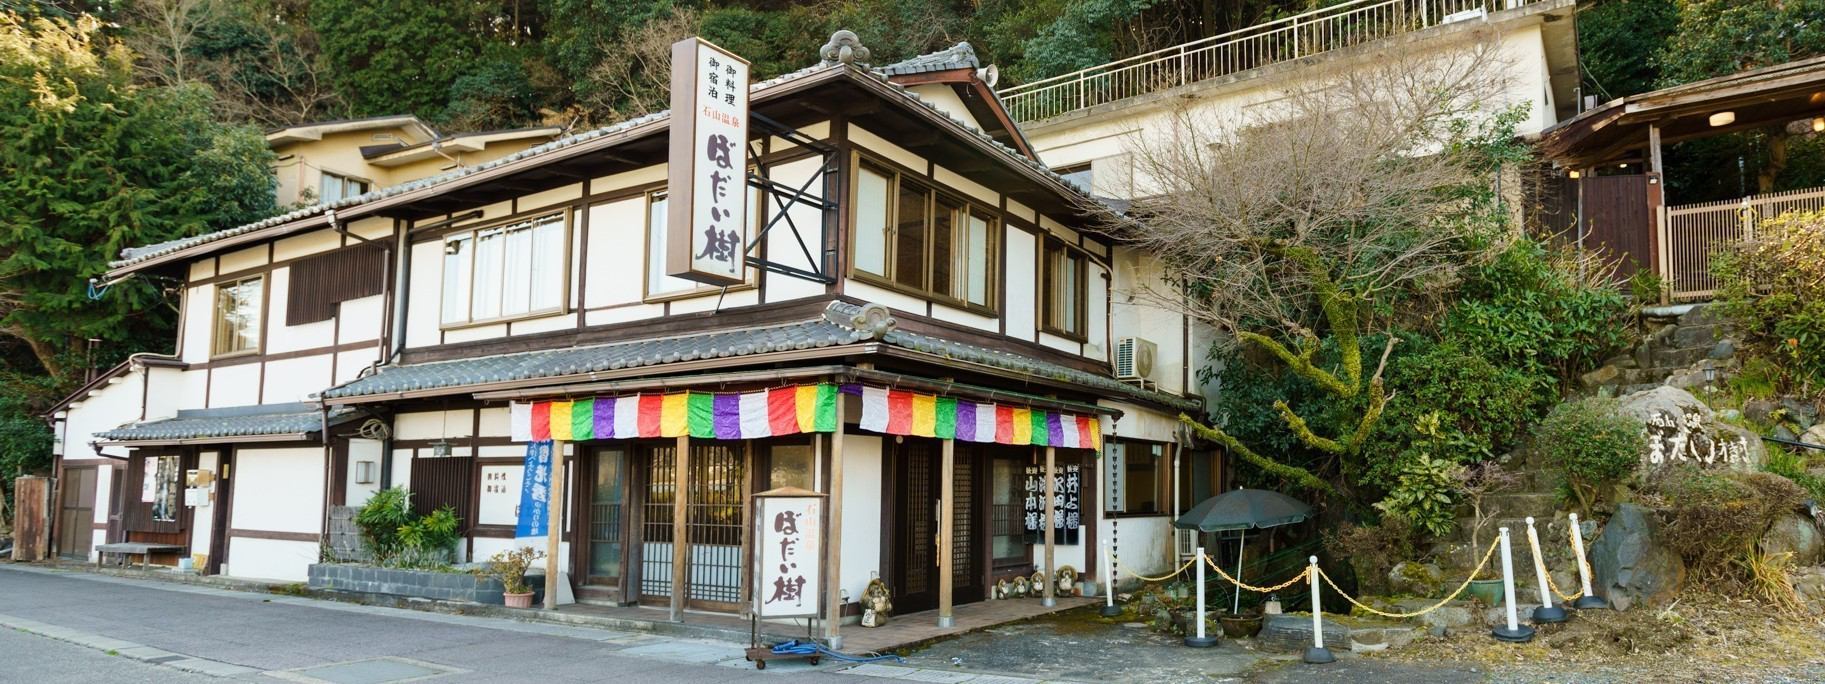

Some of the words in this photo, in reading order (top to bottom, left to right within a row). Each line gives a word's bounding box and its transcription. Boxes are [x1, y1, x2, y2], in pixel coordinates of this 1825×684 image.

[708, 56, 720, 99] 御宿泊
[725, 64, 737, 107] 御料理
[703, 106, 740, 128] 石山温泉
[695, 133, 741, 274] ぼだい樹
[765, 510, 807, 608] ぼだい樹
